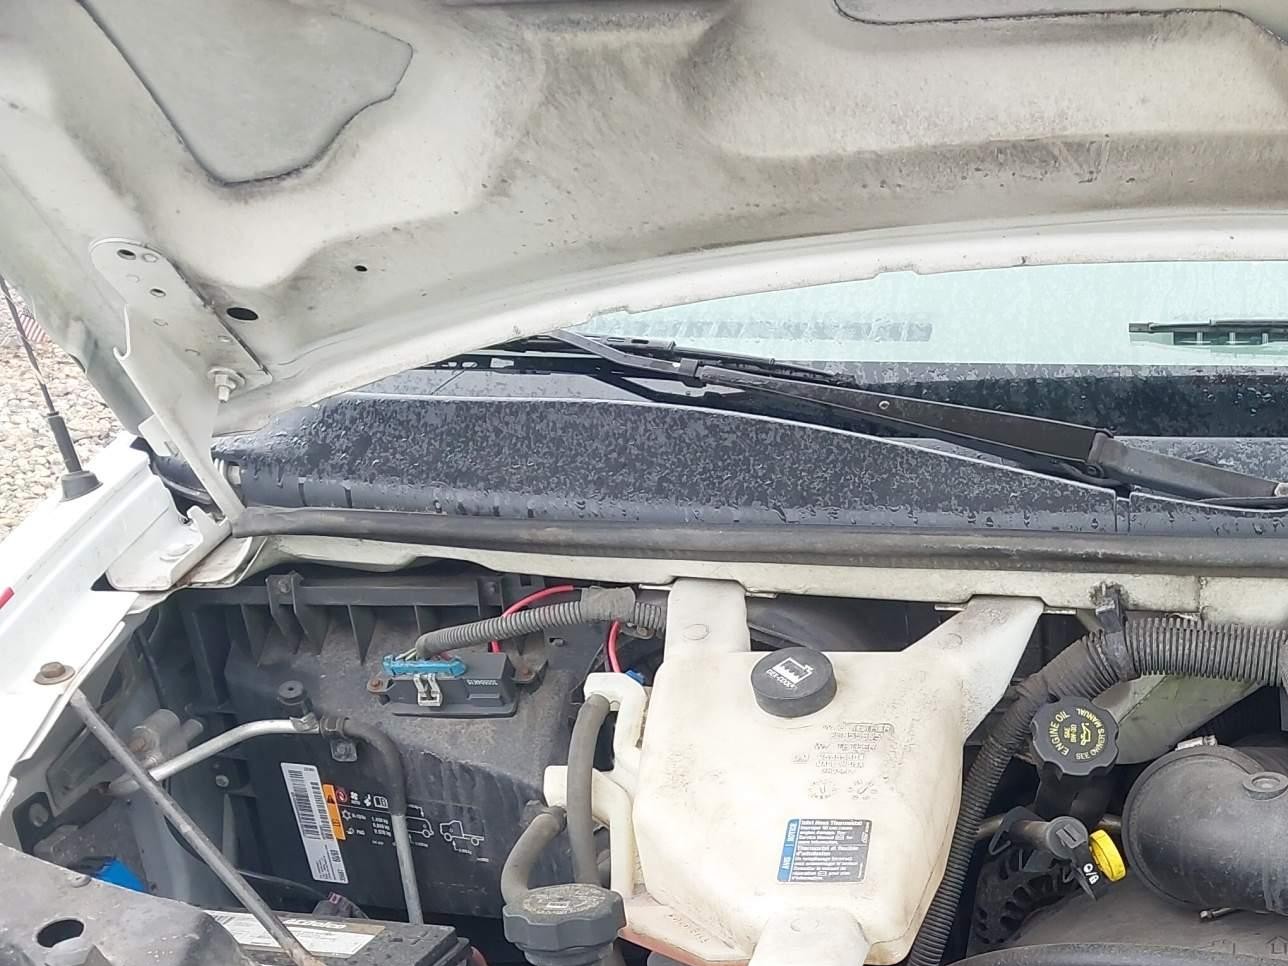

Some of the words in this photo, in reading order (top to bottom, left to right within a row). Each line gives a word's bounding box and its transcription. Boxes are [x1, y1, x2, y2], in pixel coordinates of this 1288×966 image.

[1055, 710, 1071, 722] OIL
[1075, 708, 1103, 728] MANUAL
[1048, 721, 1070, 756] ENGINE
[1075, 752, 1091, 760] SEE
